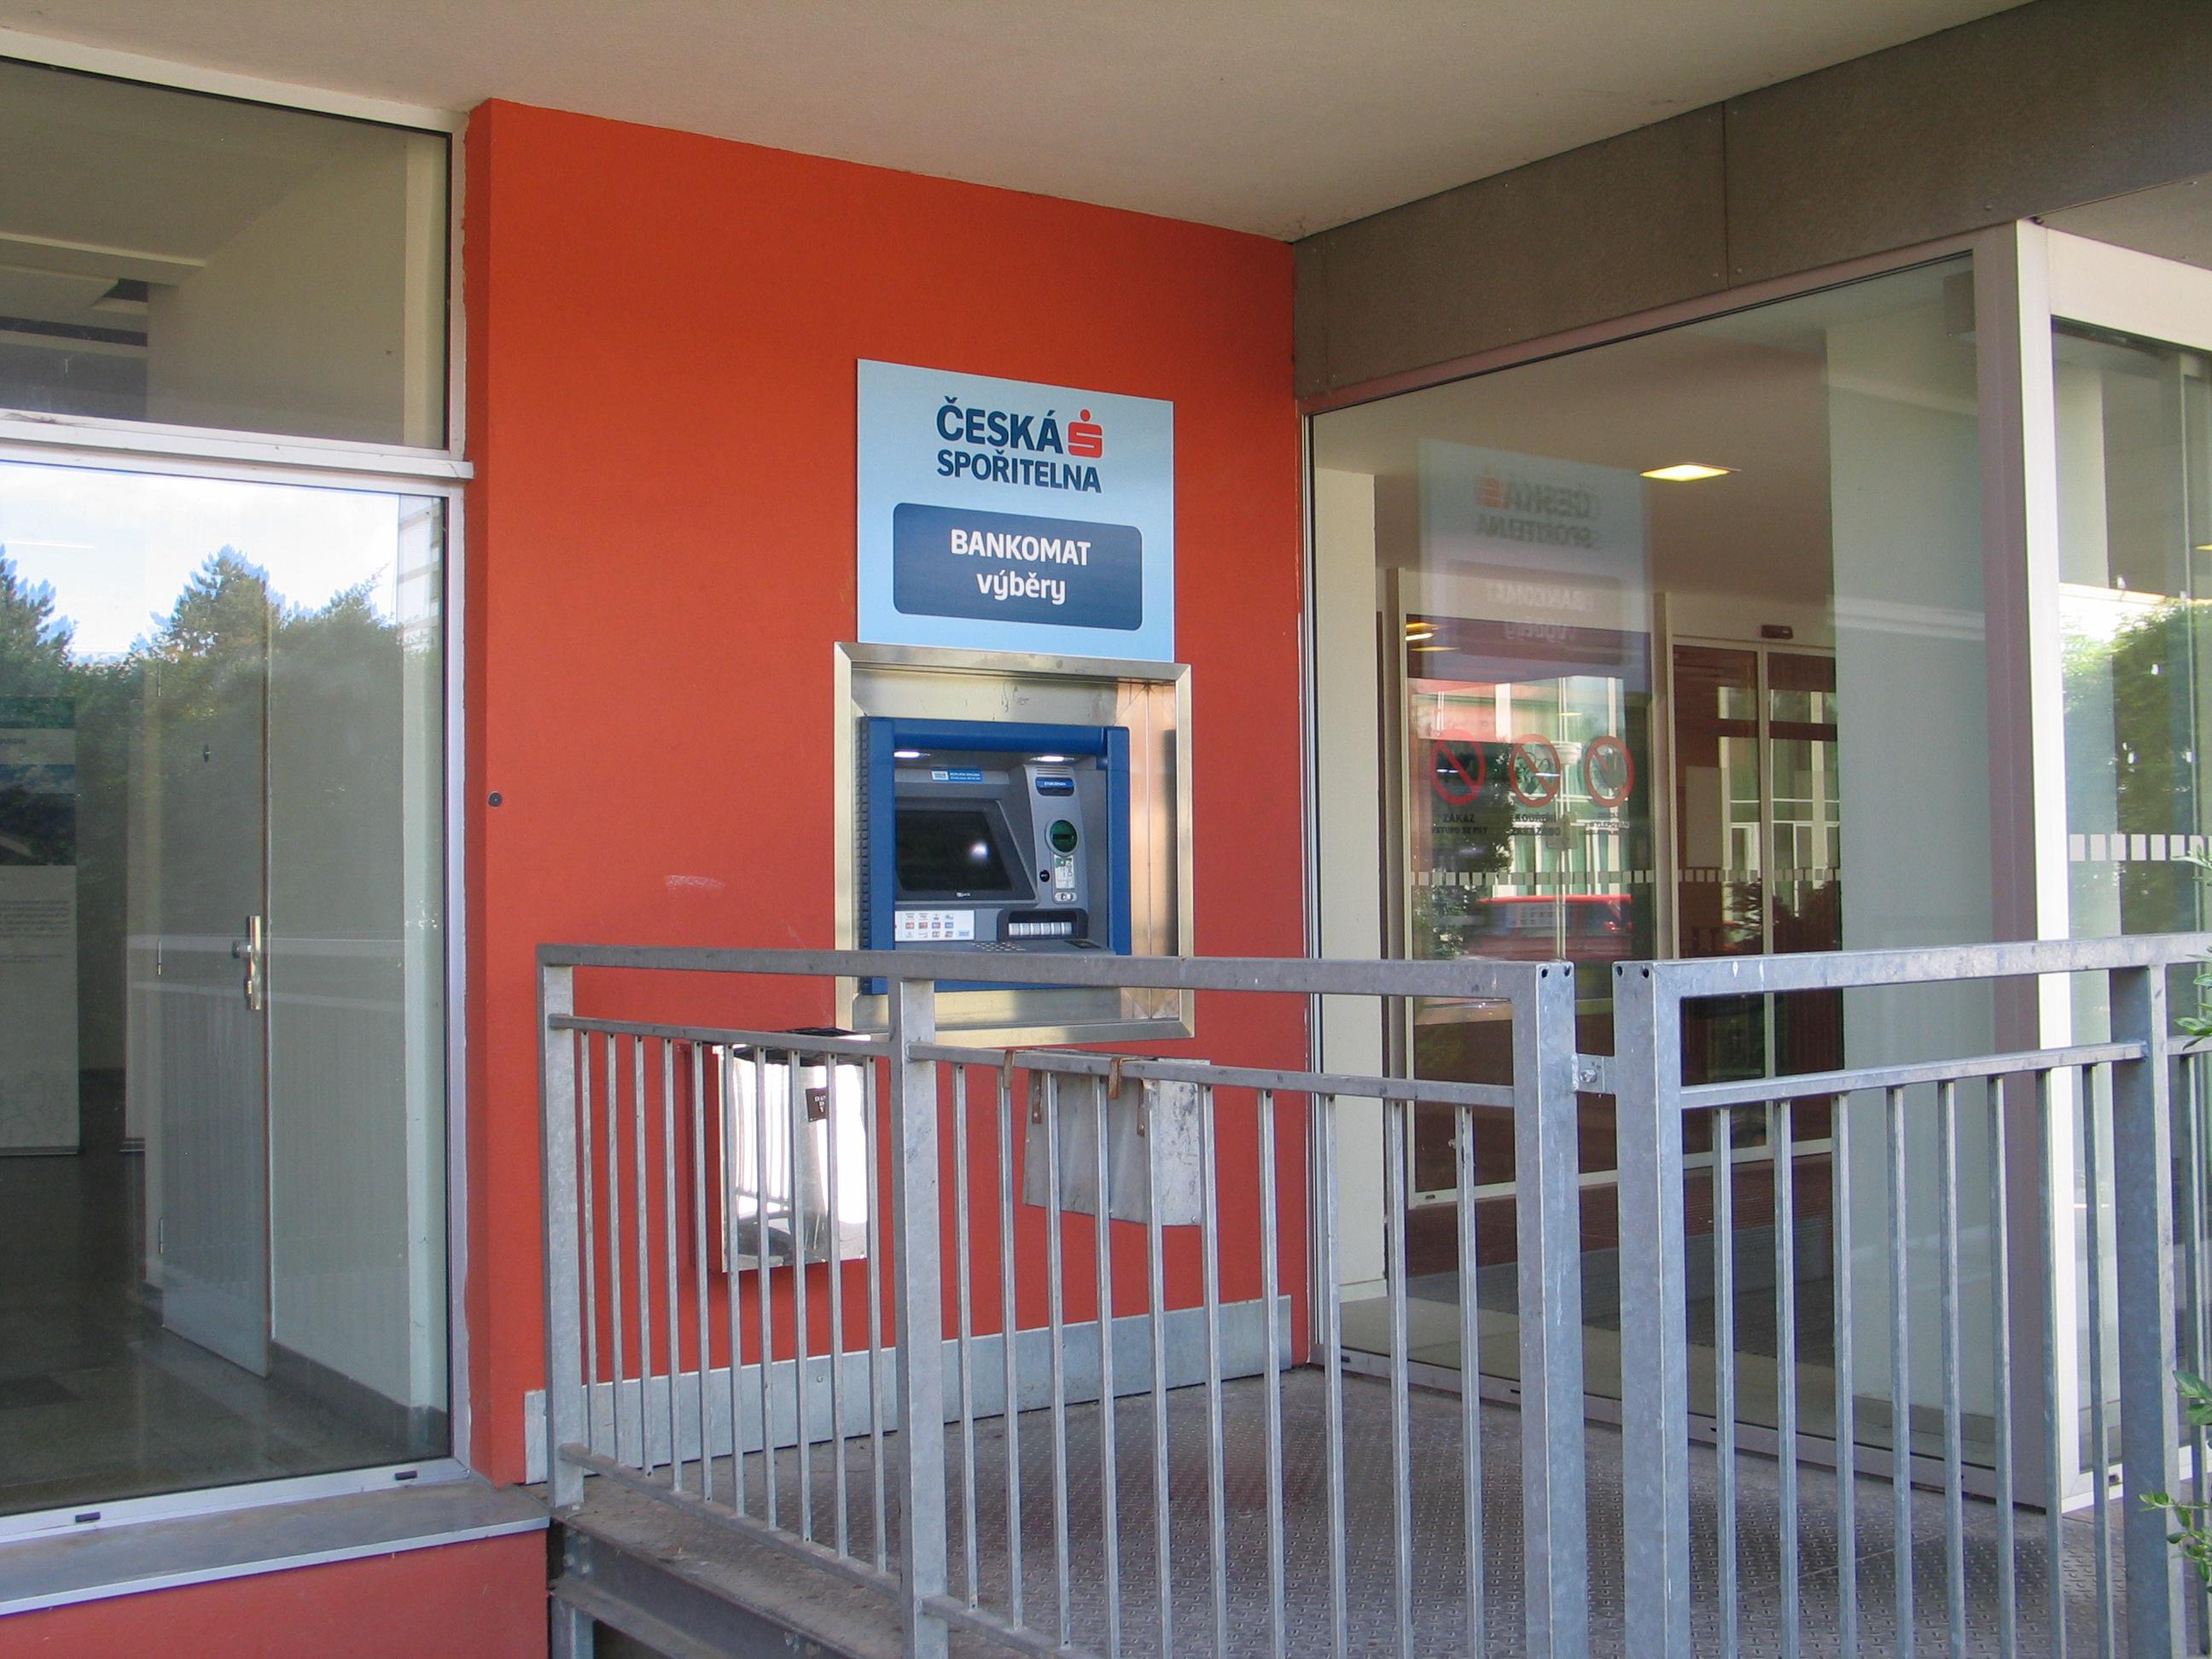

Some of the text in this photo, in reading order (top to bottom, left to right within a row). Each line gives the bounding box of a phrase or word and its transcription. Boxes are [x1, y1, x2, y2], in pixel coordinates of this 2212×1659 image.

[936, 396, 1063, 454] ČESKÁ
[936, 449, 1102, 493] SPOŘITELNA
[951, 529, 1091, 566] BANKOMAT
[976, 570, 1067, 605] výběry
